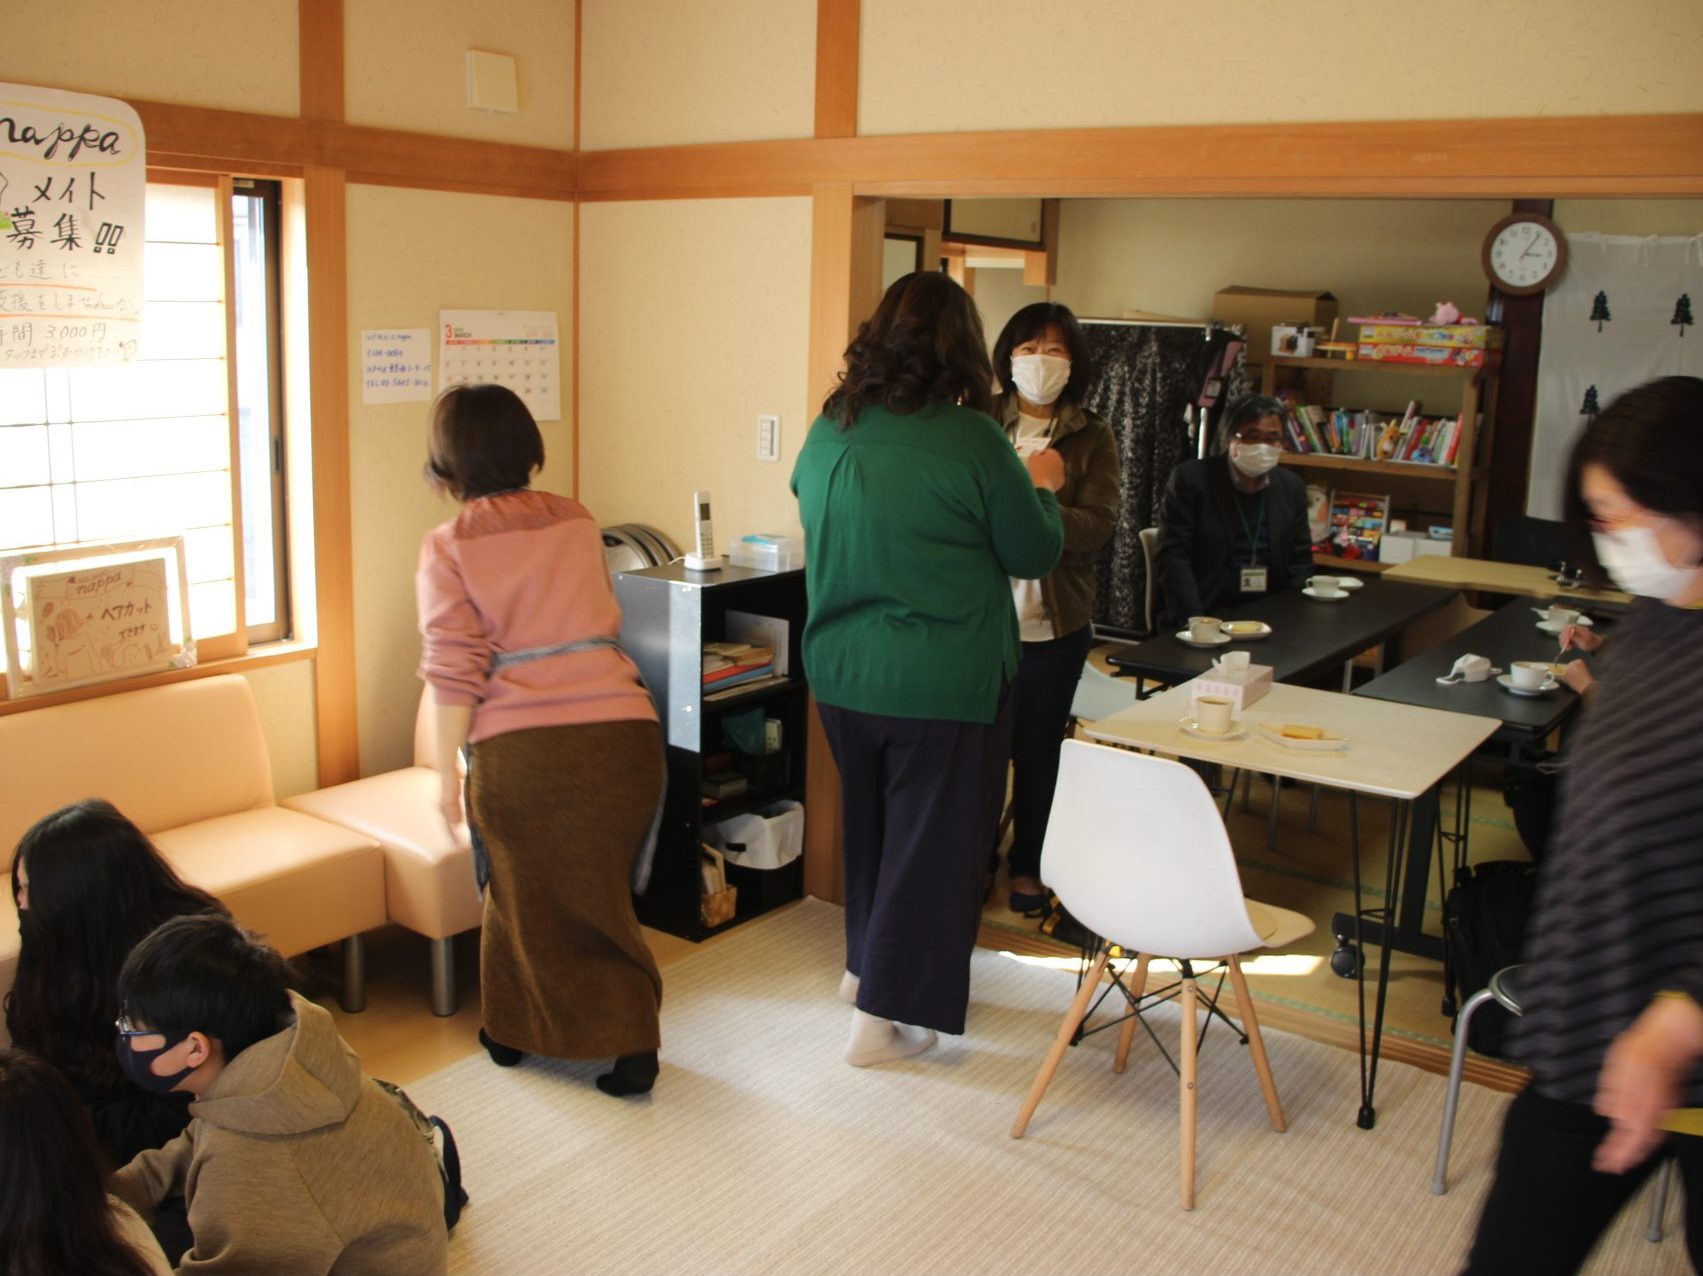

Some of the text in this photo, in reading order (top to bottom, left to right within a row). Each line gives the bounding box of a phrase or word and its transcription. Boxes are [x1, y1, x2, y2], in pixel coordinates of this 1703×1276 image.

[32, 172, 105, 211] メイト
[444, 324, 453, 338] 3
[76, 571, 122, 595] nappa
[100, 597, 152, 621] ヘアカット
